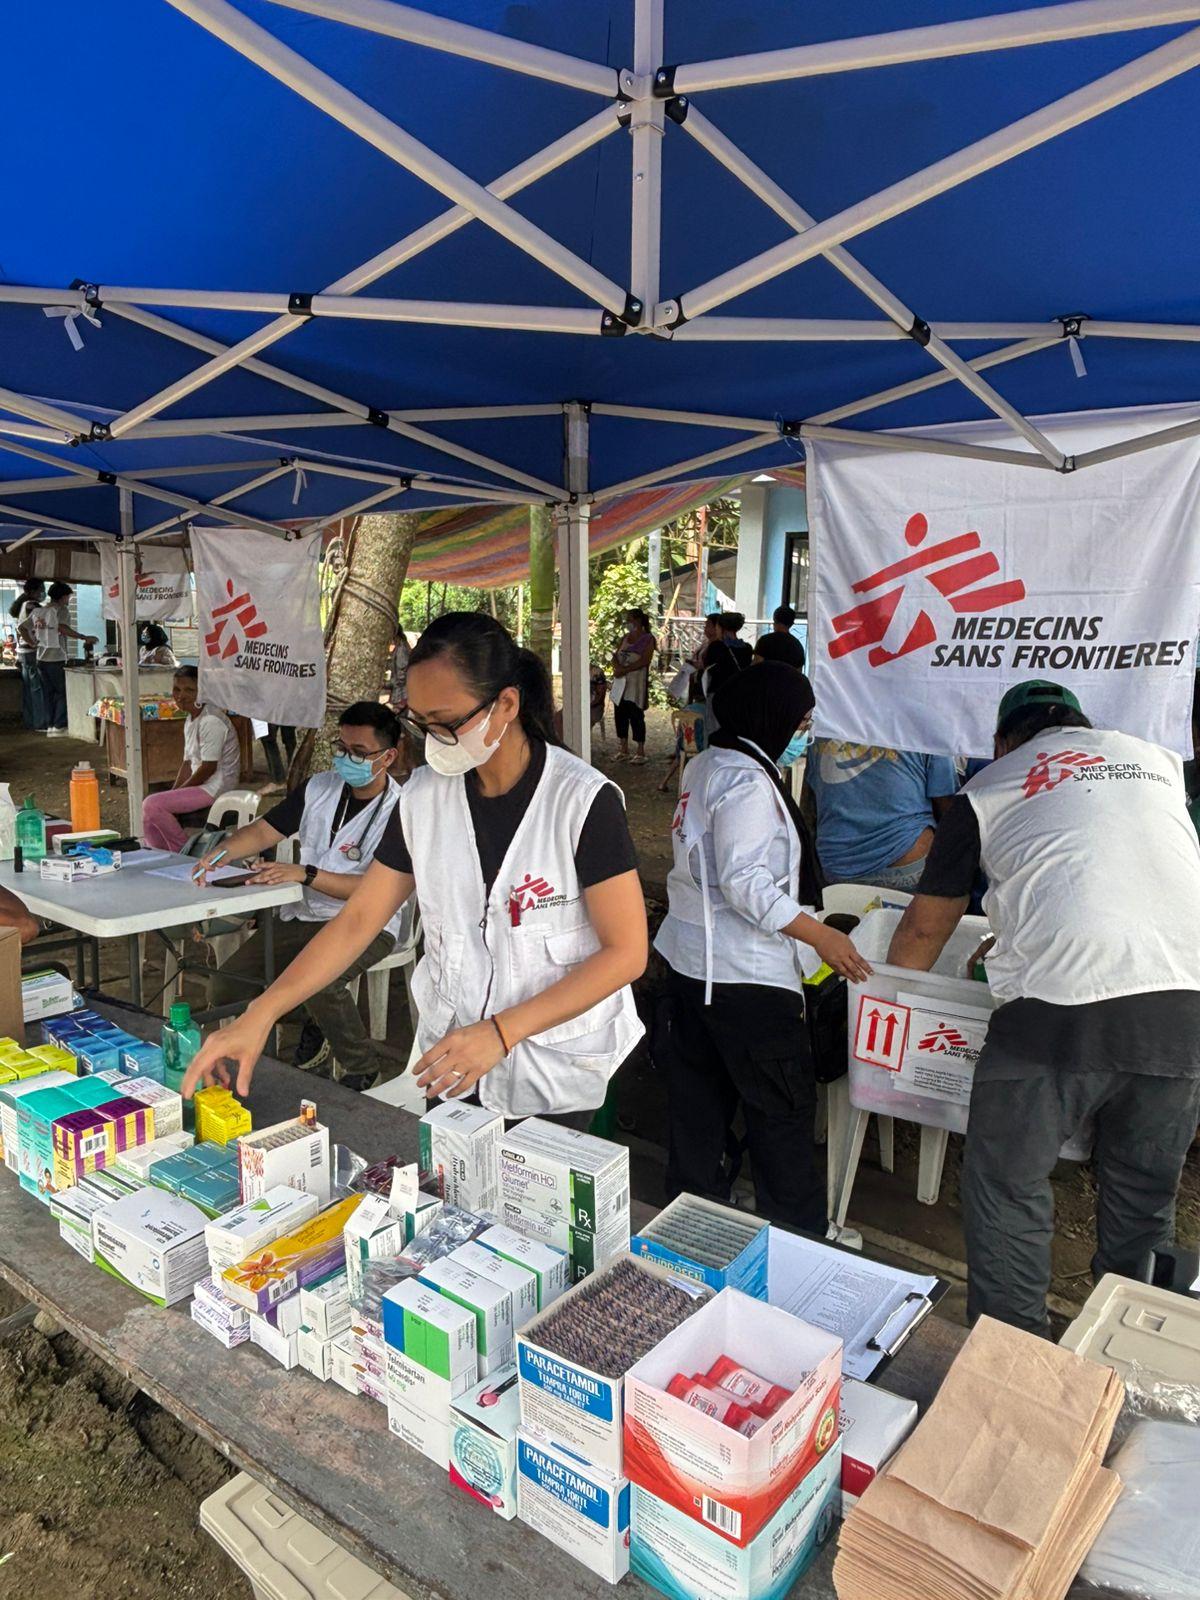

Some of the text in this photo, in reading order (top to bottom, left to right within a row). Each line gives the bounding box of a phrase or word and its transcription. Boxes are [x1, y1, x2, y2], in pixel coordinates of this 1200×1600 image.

[951, 616, 1103, 641] MEDECINS
[243, 640, 288, 659] MEDECINS
[930, 640, 1189, 670] SANS FRONTIERES
[234, 655, 261, 672] SANS
[1073, 772, 1105, 782] SANS
[1080, 763, 1142, 773] MEDECINS
[537, 894, 567, 903] MEDECINS
[502, 1160, 540, 1181] Metformin
[541, 1173, 555, 1187] HCl
[504, 1209, 537, 1232] Metformin
[387, 1352, 426, 1385] Telmisartan
[526, 1350, 601, 1397] PARACETAMOL
[537, 1369, 590, 1406] TEMPRA FORTE
[526, 1447, 599, 1503] PARACETAMOL
[536, 1468, 588, 1509] TEMPRA FORTE
